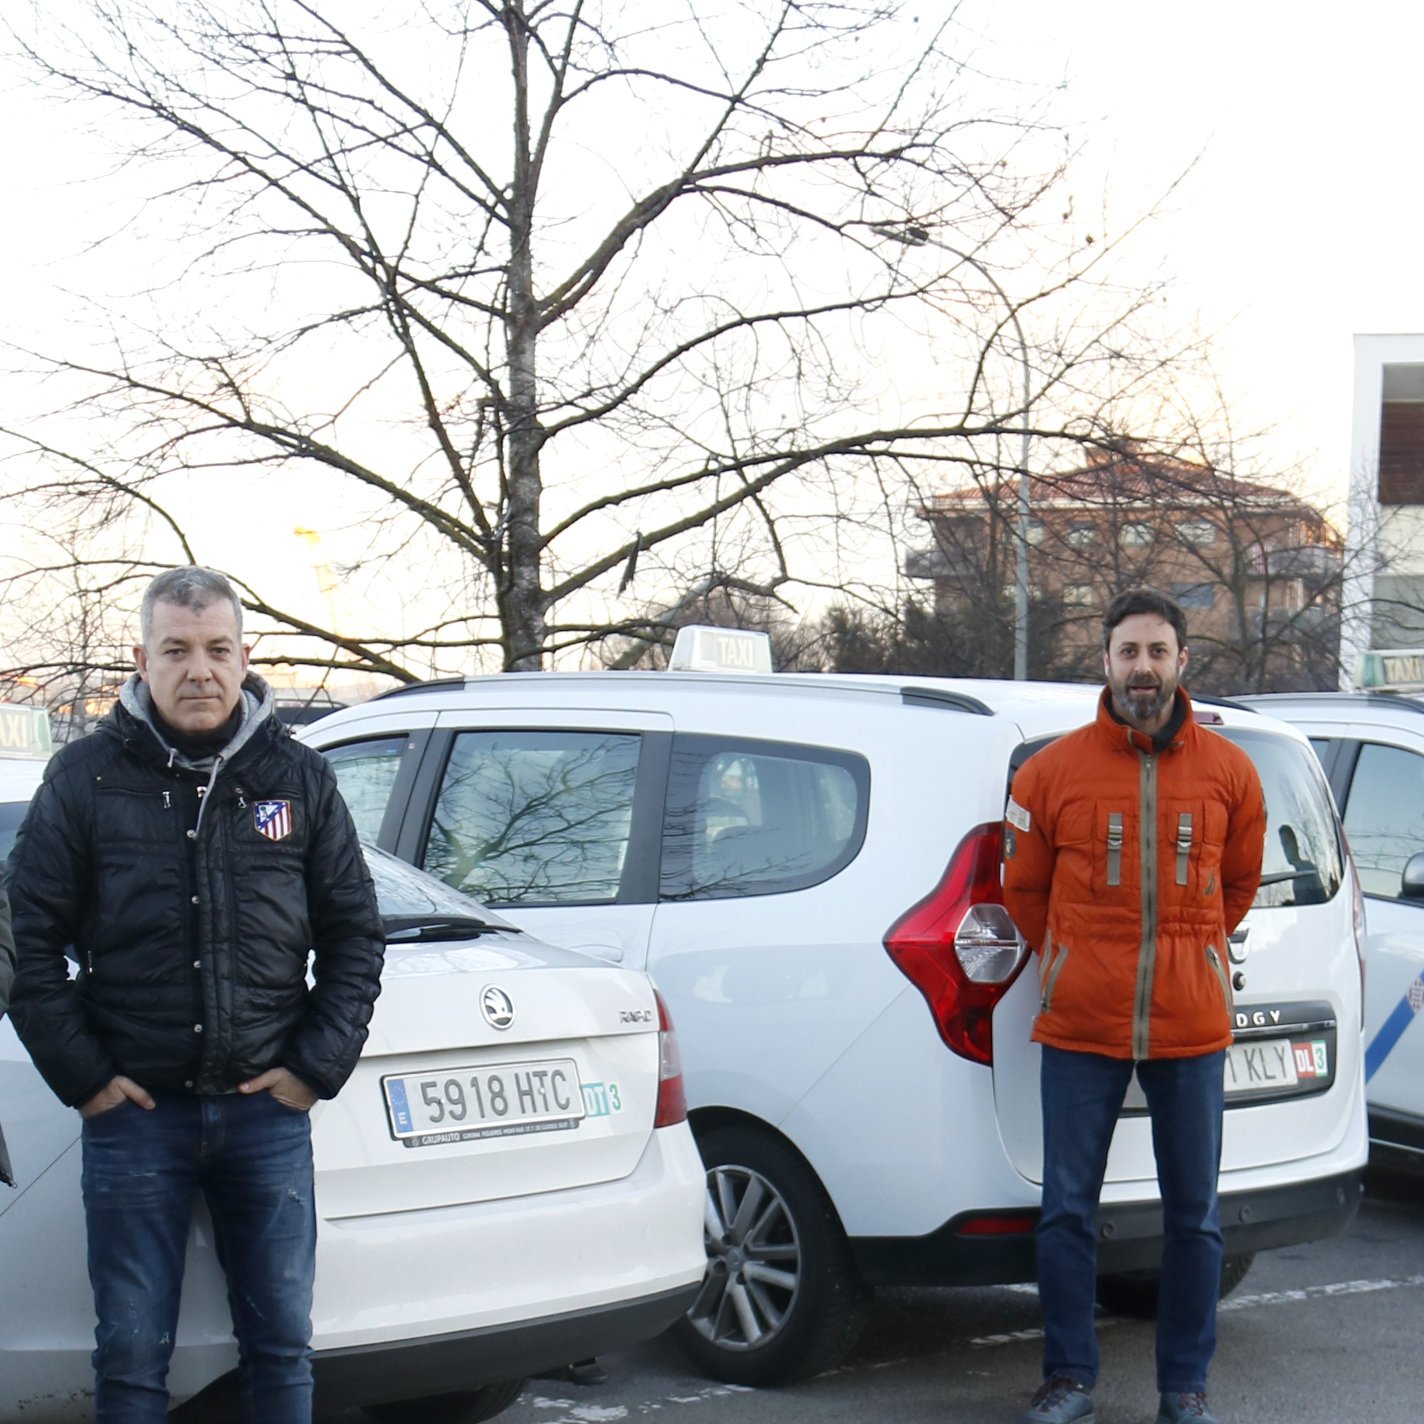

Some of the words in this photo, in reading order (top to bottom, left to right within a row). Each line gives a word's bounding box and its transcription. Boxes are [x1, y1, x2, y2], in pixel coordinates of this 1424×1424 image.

[718, 637, 753, 667] TAXI
[1384, 658, 1422, 681] TAXI
[1236, 1009, 1281, 1027] DGY
[1243, 1046, 1288, 1083] KLY
[1294, 1048, 1315, 1073] DL
[1315, 1046, 1325, 1070] 3
[397, 1111, 409, 1125] E
[421, 1074, 509, 1123] 5918
[514, 1069, 571, 1114] HTC
[582, 1086, 606, 1116] DT
[609, 1083, 622, 1111] 3
[421, 1132, 461, 1145] GRUPAUTO
